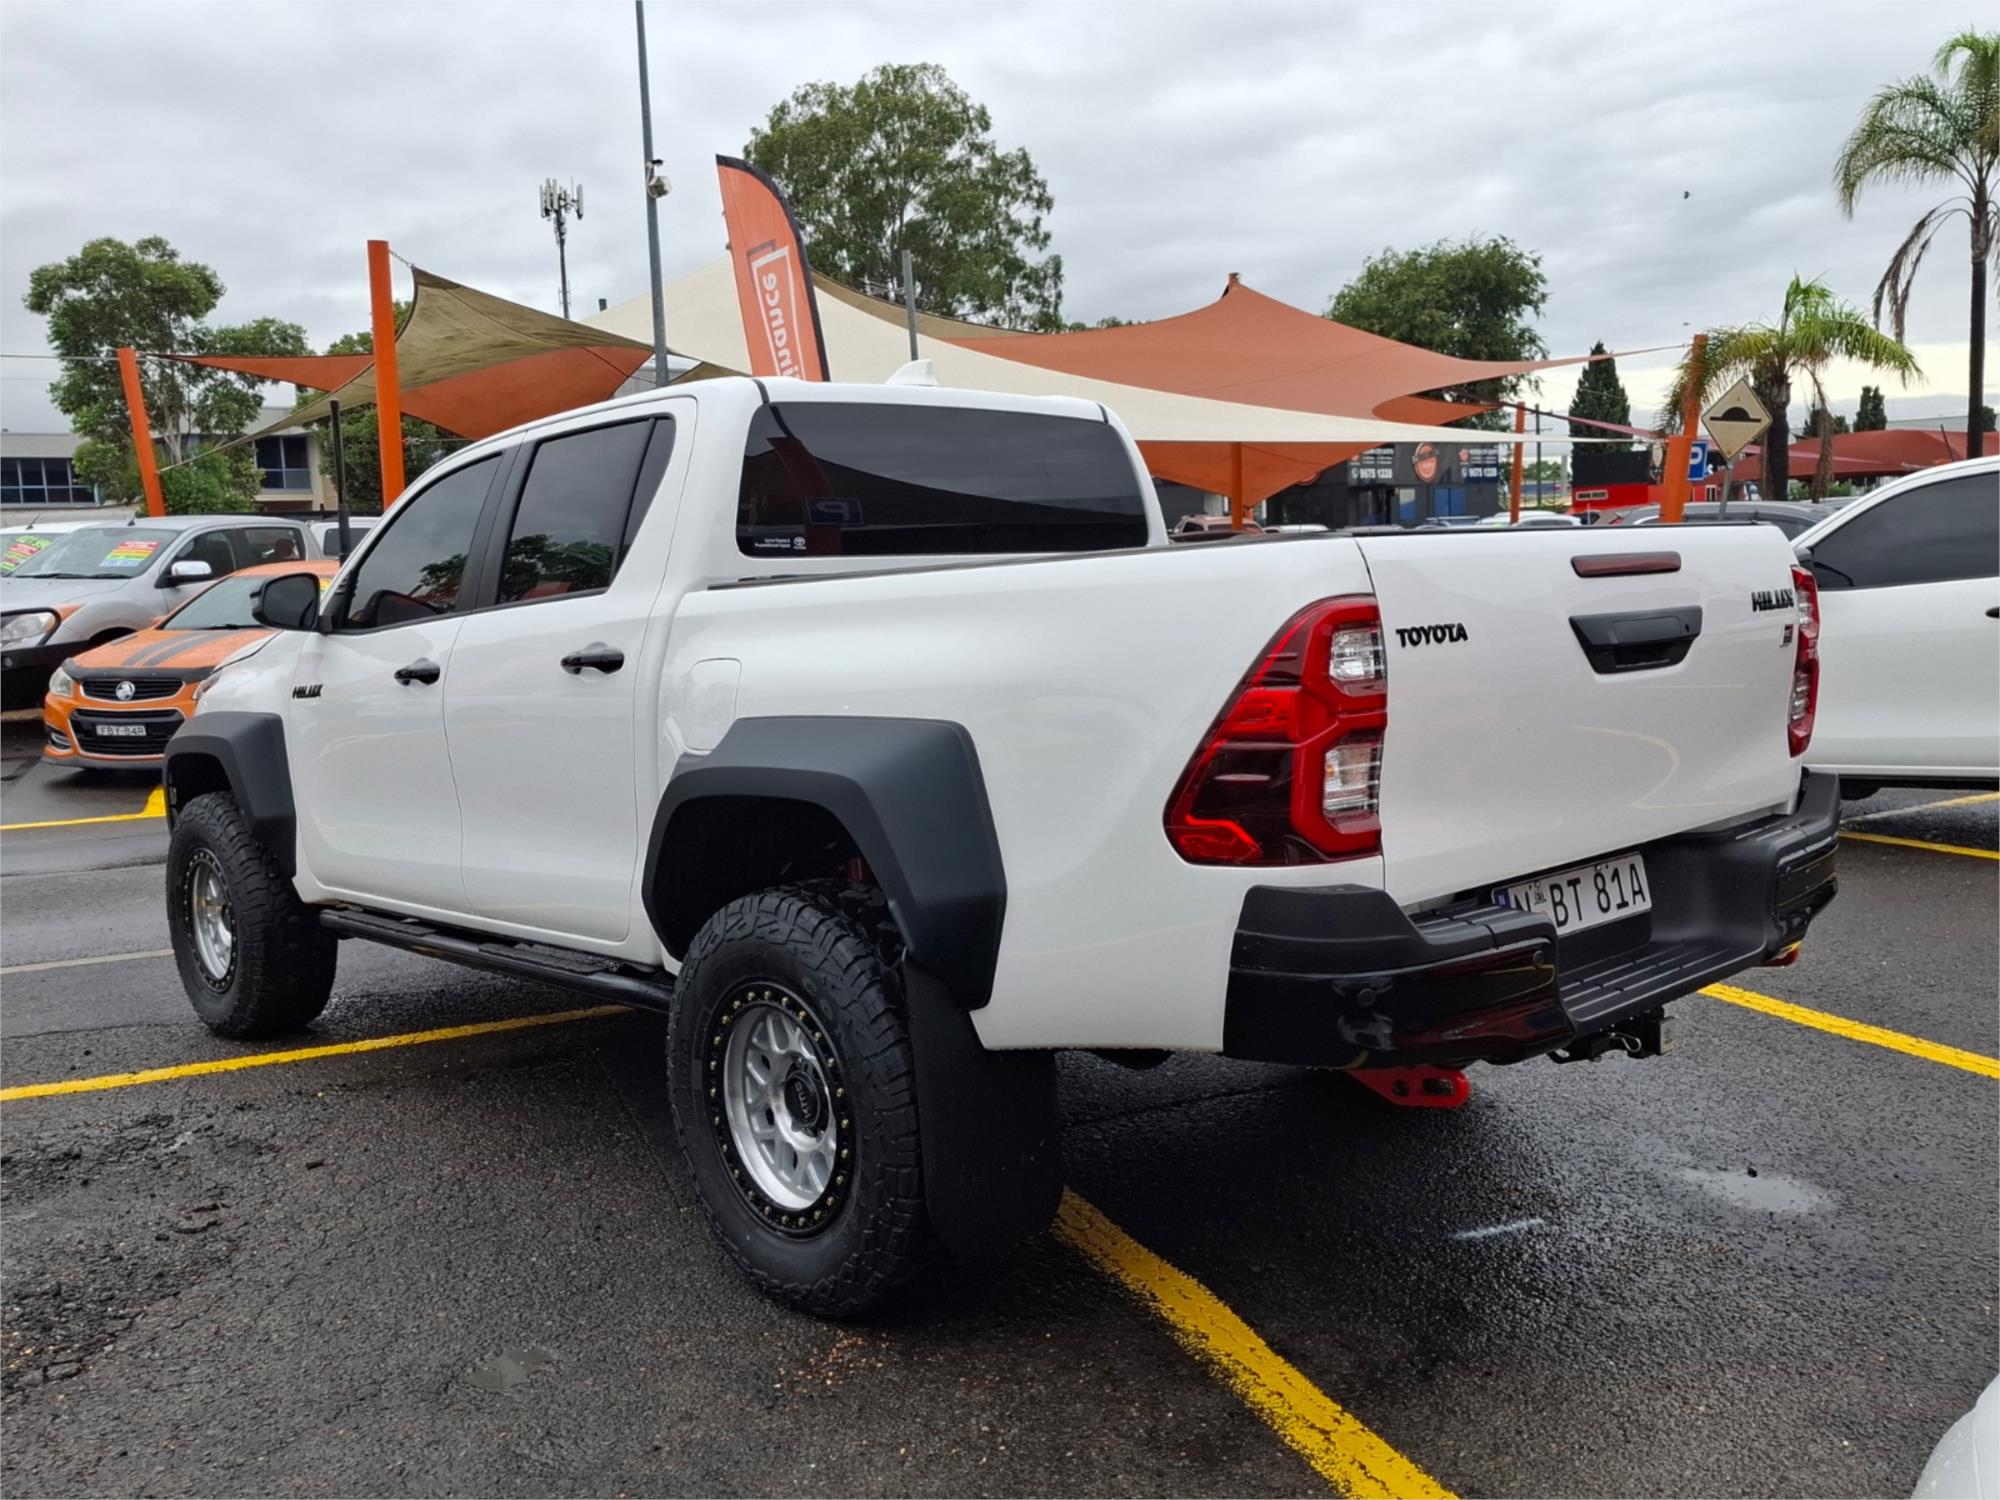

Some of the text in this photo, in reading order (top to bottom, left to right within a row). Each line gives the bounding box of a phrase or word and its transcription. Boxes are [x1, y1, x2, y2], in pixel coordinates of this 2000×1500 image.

[1395, 622, 1469, 649] TOYOTA
[1548, 876, 1583, 929] BT
[1593, 862, 1647, 914] 81A
